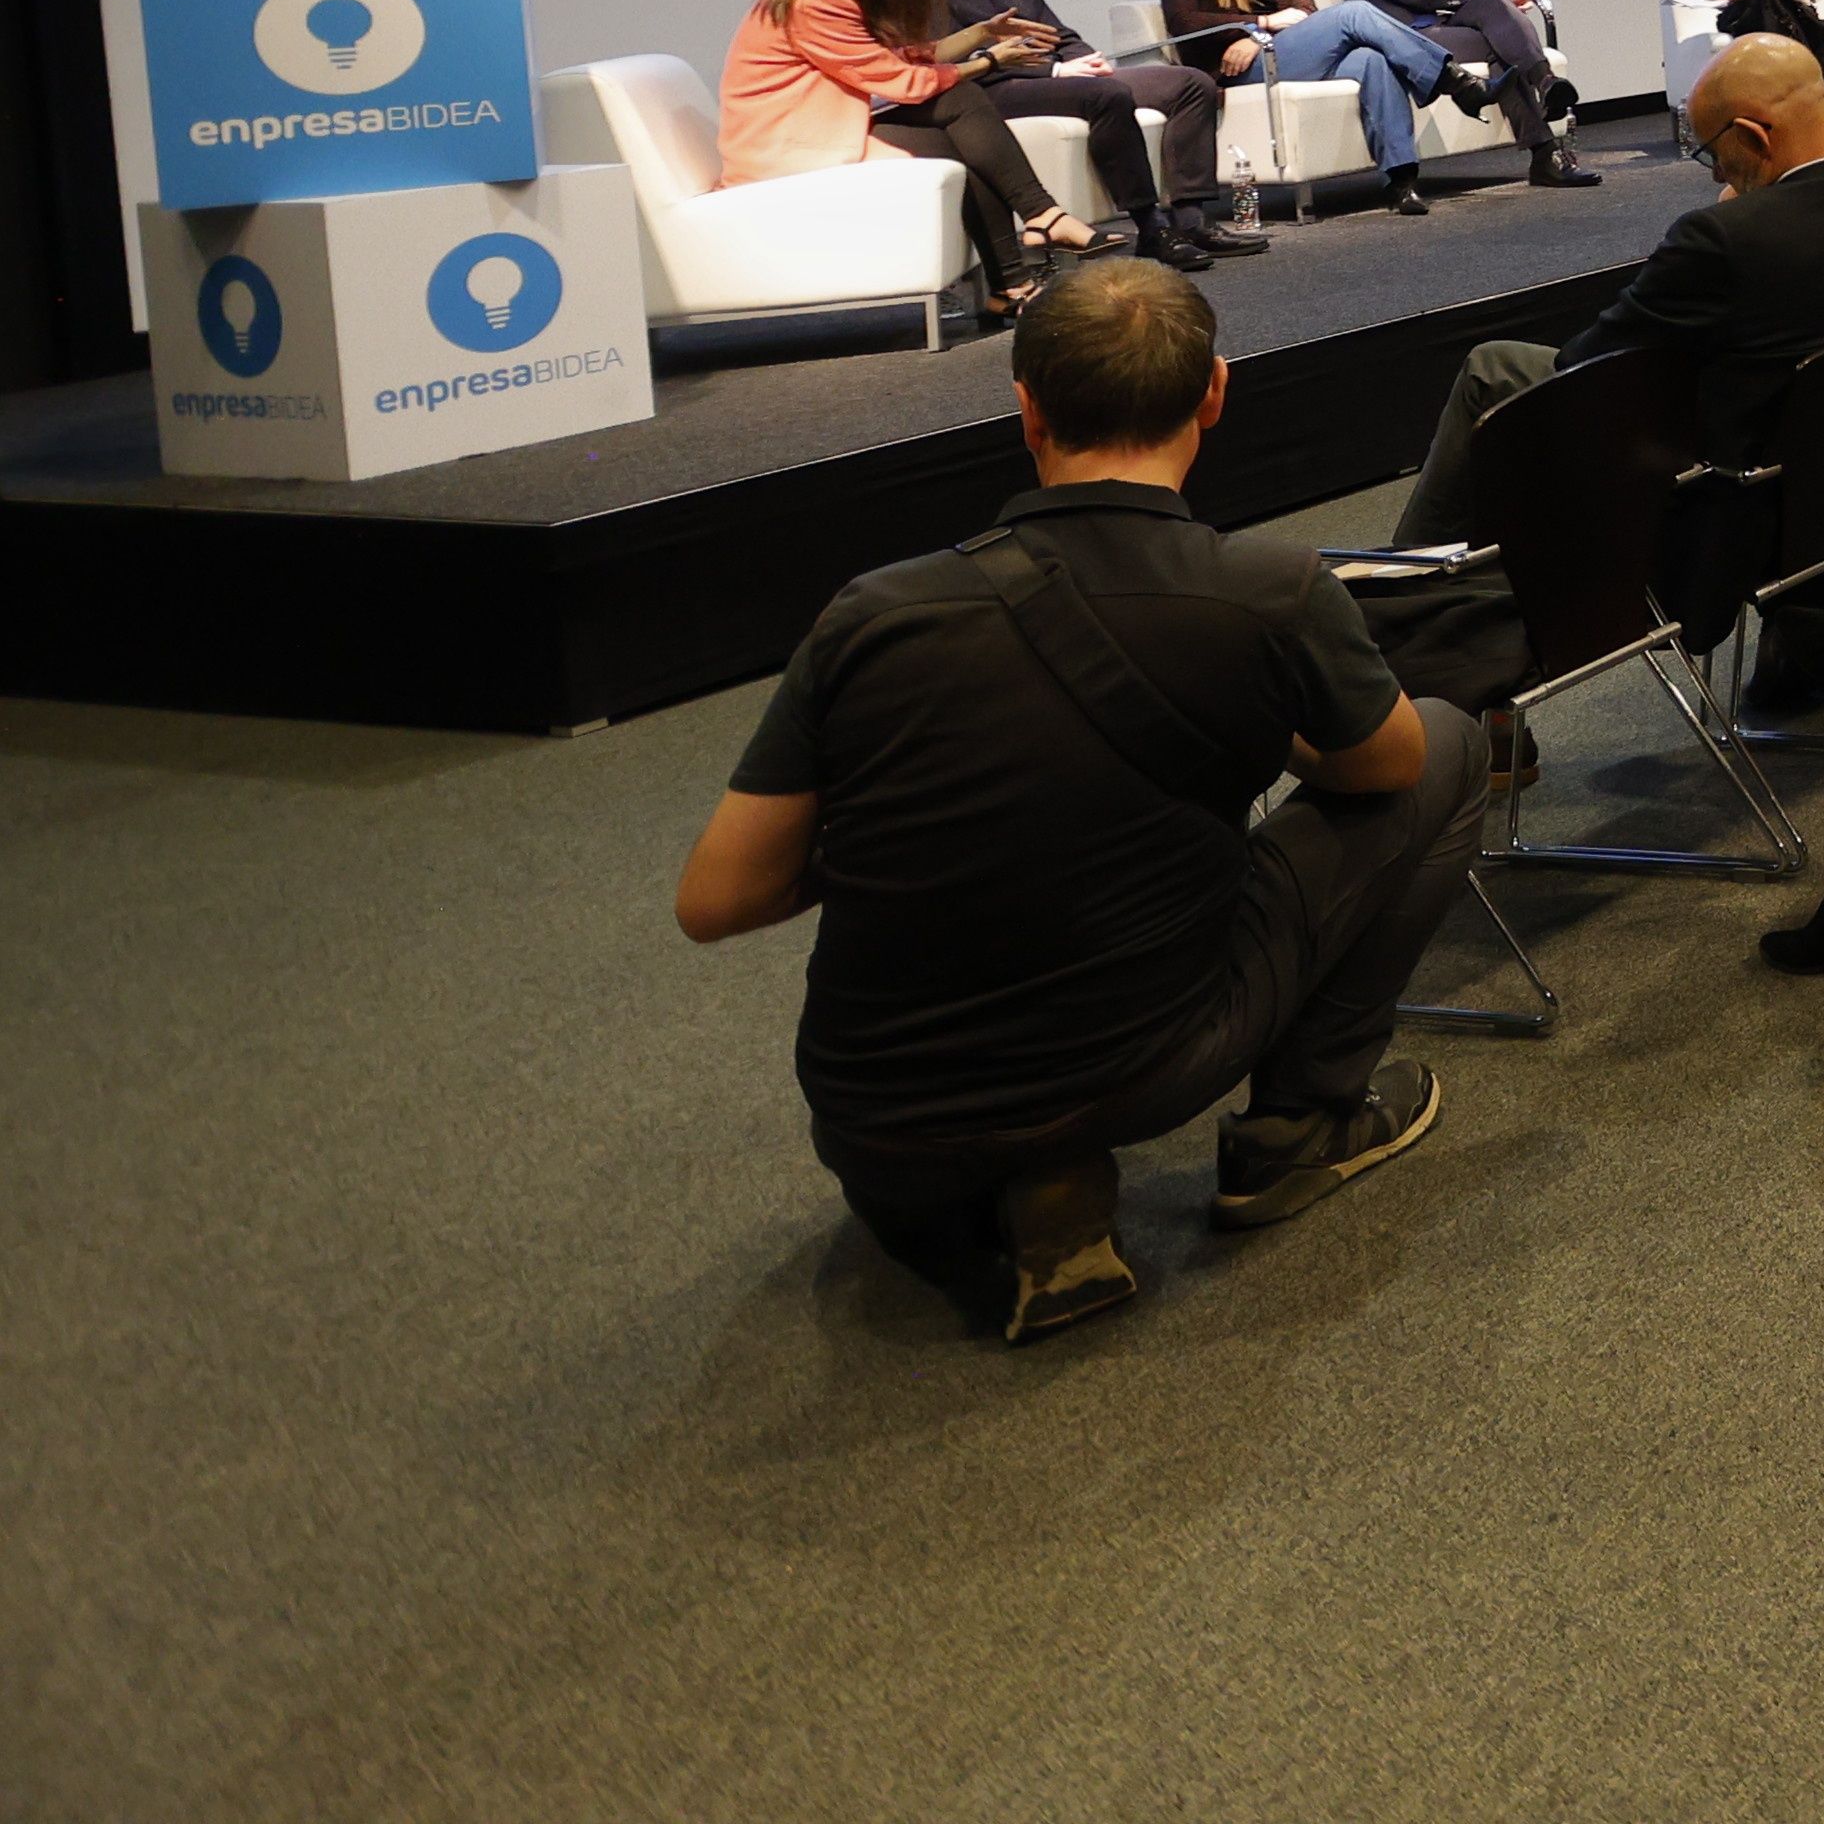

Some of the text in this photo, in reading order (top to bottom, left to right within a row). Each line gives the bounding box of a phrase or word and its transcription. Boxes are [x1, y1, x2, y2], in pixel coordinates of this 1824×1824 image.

[188, 99, 502, 151] enpresaBIDEA
[171, 389, 329, 424] enpresaBIDEA
[373, 346, 625, 416] enpresaBIDEA
